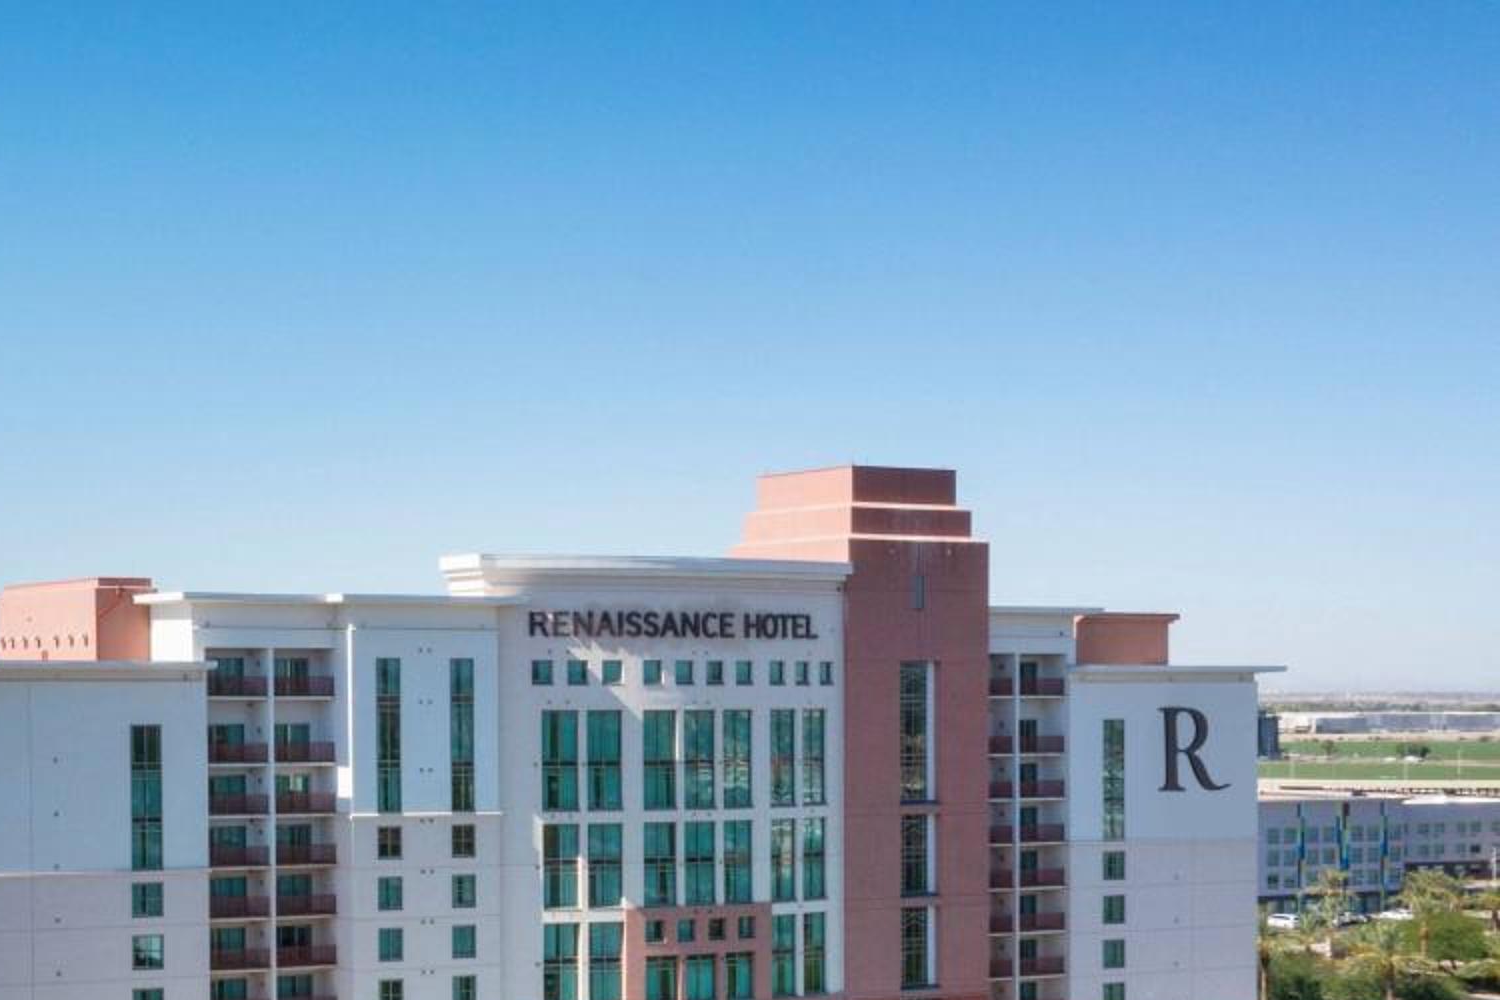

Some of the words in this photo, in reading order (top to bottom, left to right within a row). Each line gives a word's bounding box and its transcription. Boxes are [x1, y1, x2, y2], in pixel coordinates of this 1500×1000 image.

[528, 611, 735, 638] RENAISSANCE
[743, 613, 818, 639] HOTEL
[1157, 706, 1232, 792] R
